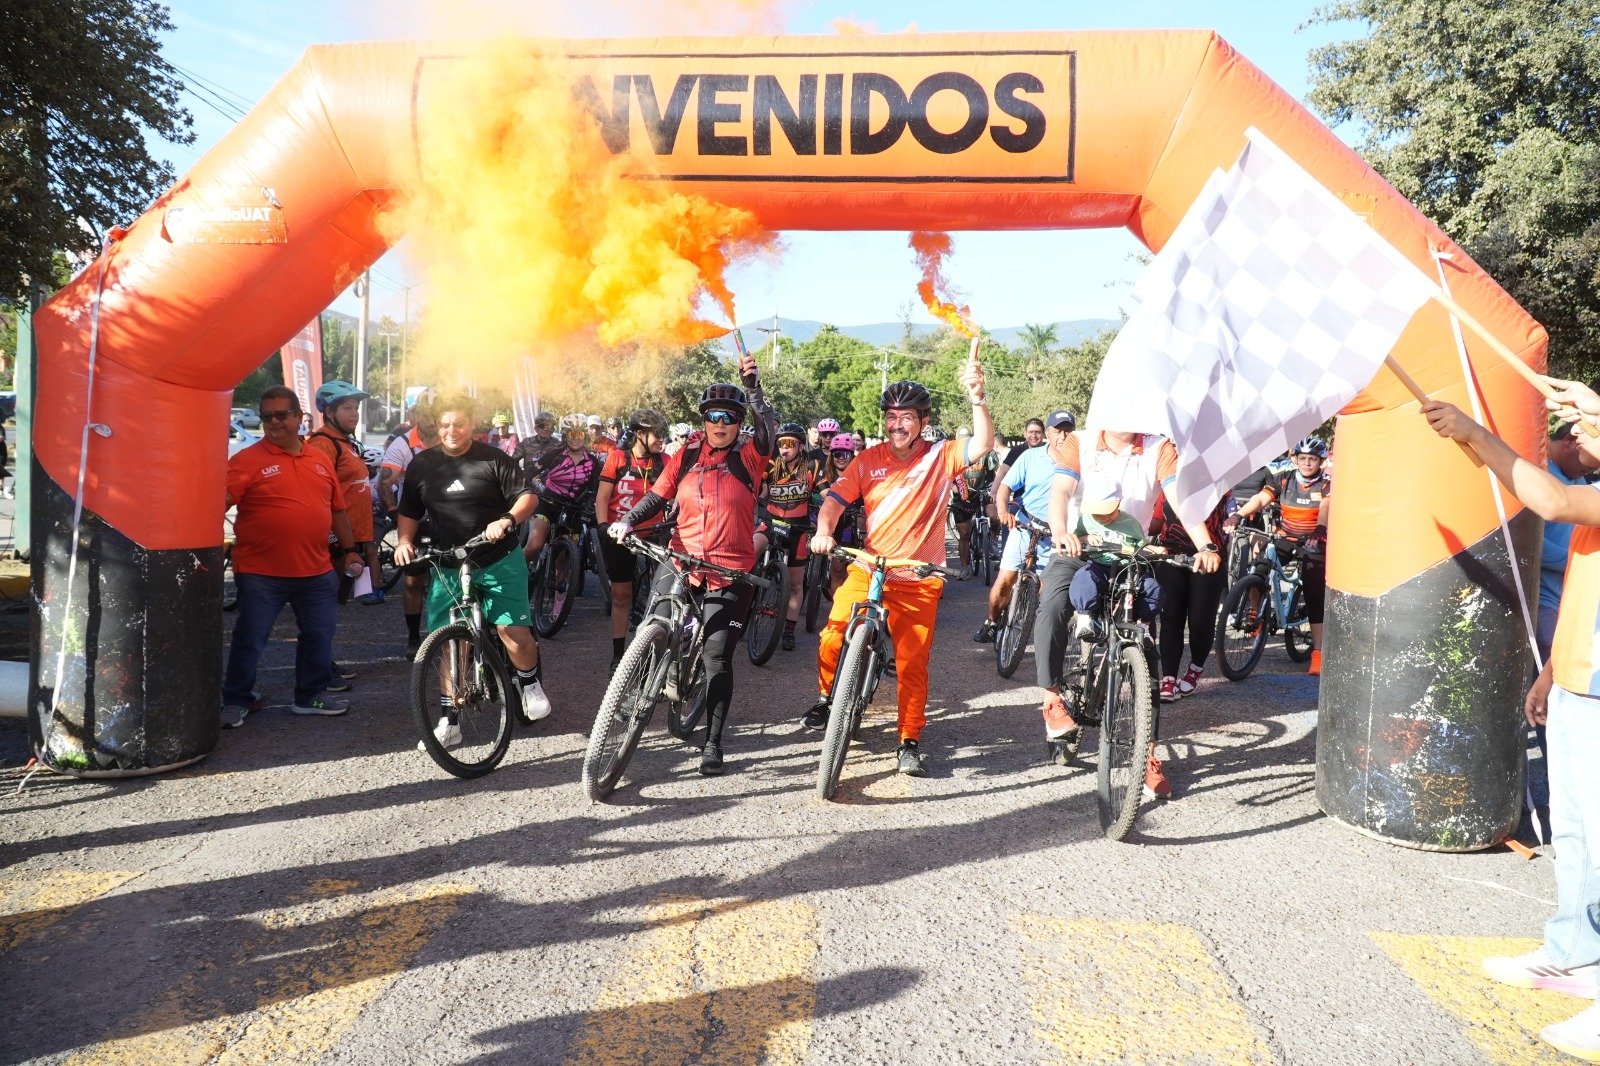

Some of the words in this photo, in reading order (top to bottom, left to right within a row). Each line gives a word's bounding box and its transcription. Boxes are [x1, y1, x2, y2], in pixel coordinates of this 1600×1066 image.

[570, 72, 1046, 155] NVENIDOS
[261, 464, 280, 475] UAT
[870, 468, 888, 477] UAT
